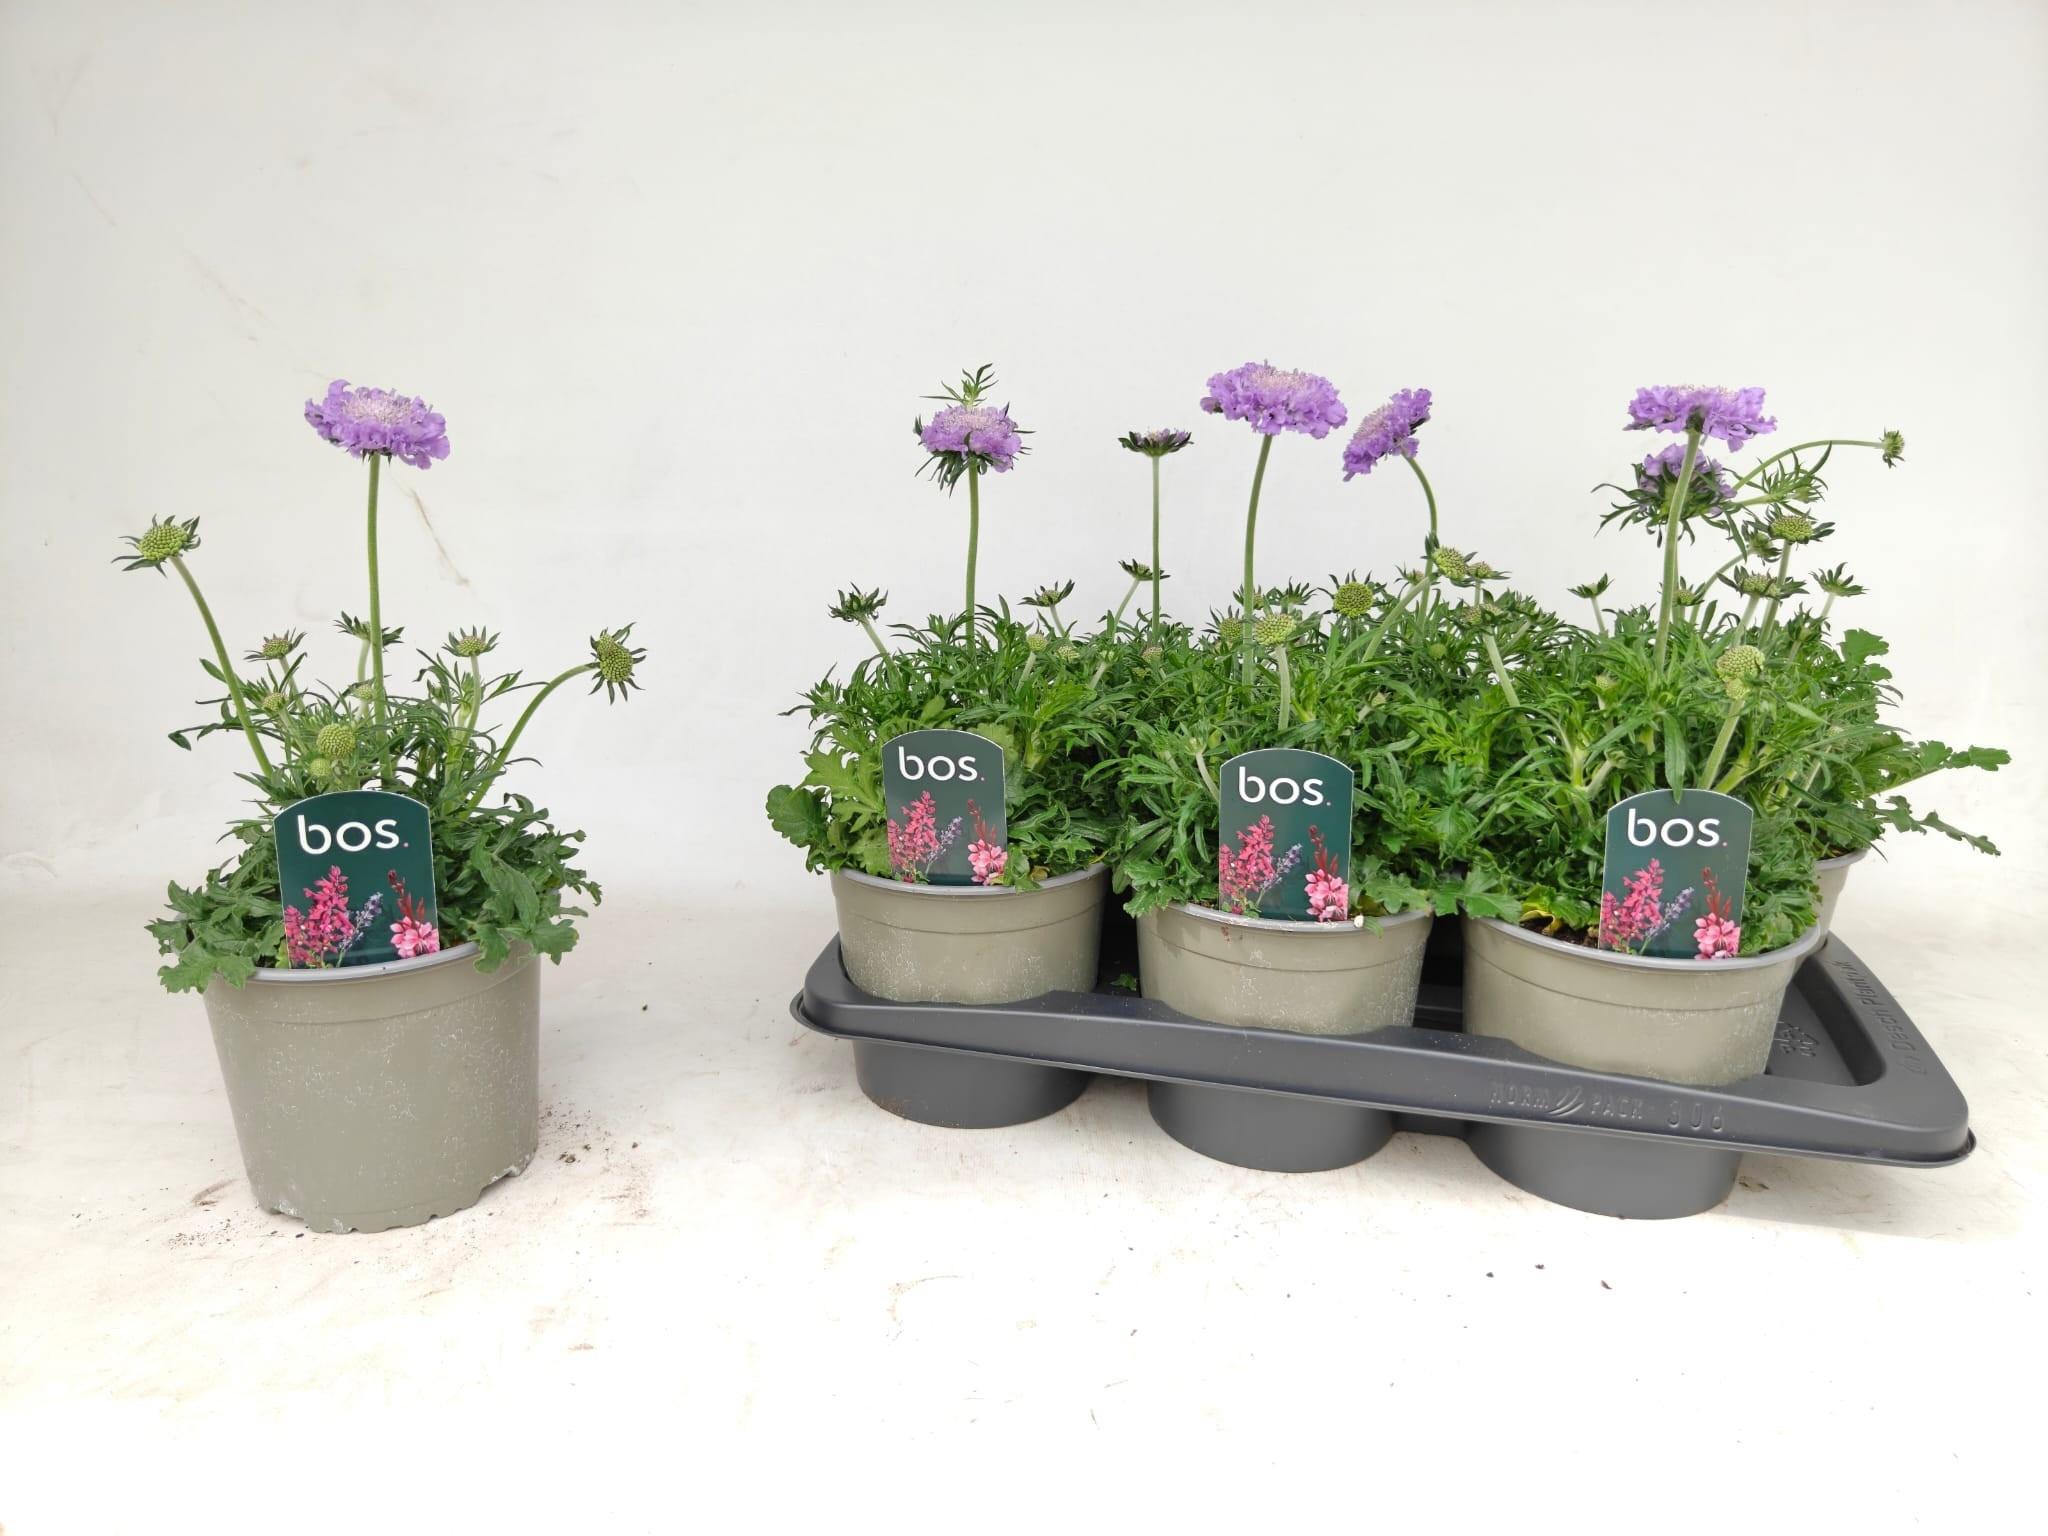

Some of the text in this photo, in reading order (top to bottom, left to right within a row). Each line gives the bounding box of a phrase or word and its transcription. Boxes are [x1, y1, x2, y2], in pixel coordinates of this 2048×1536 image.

[898, 745, 985, 782] bos.
[1238, 766, 1331, 806] bos.
[297, 814, 409, 855] bos.
[1627, 808, 1728, 847] bos.
[1590, 1094, 1643, 1120] PACK
